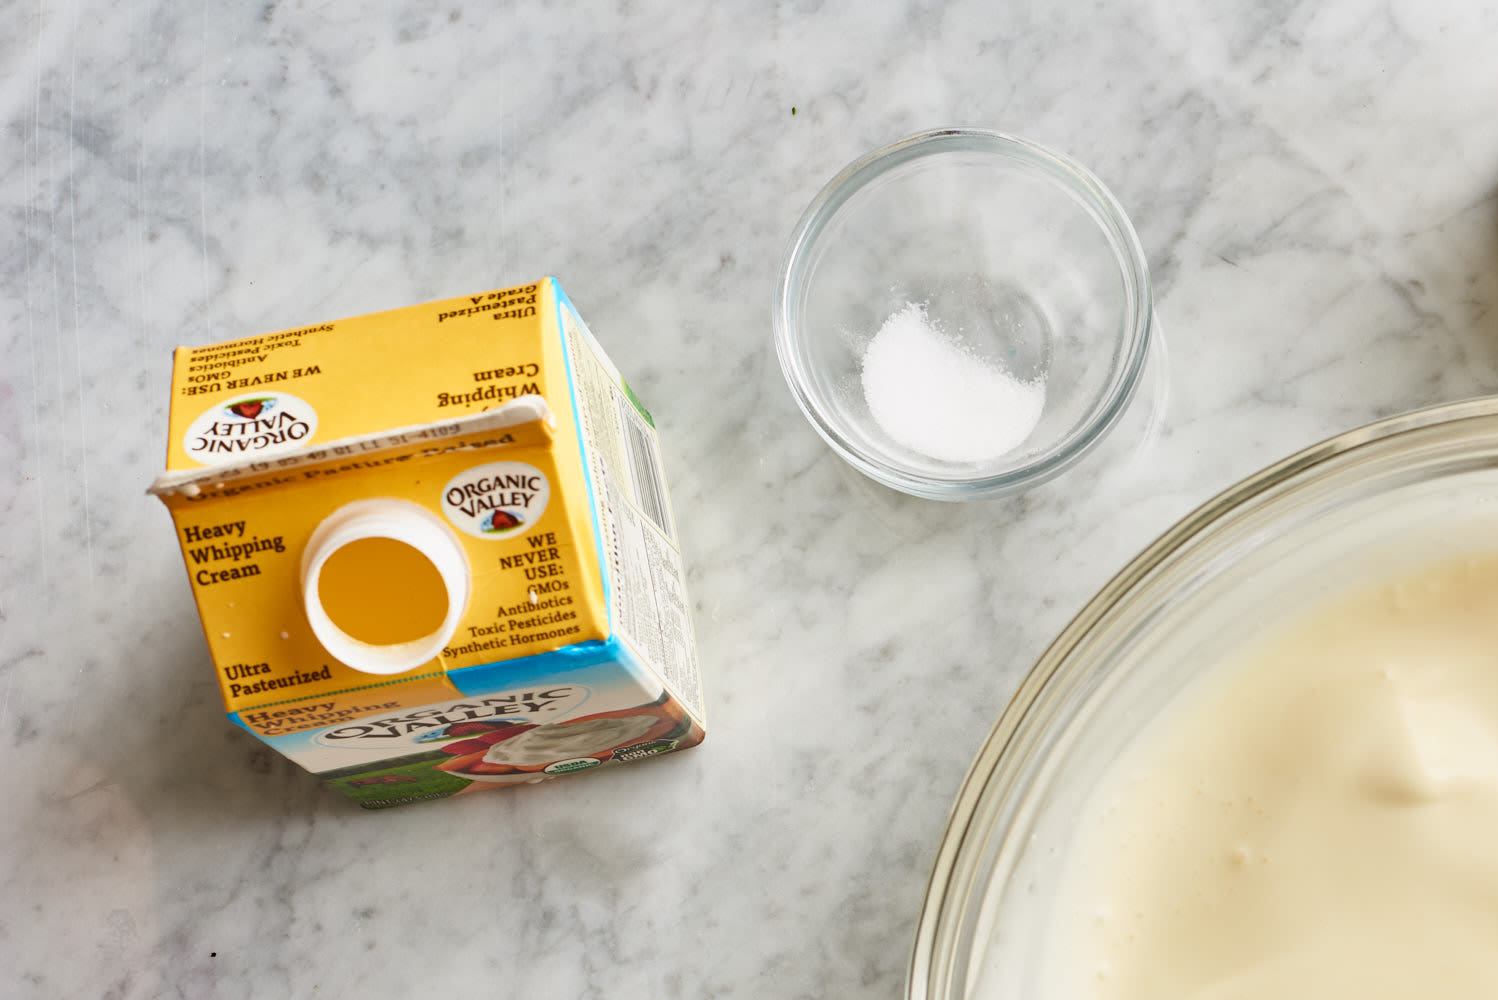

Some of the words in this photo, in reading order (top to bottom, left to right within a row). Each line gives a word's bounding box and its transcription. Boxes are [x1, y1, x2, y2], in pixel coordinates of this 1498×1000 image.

[487, 284, 537, 301] Grade
[438, 294, 537, 322] Pasteurized
[493, 306, 537, 321] Ultra
[270, 324, 335, 343] Synthetic
[190, 346, 260, 363] Pesticides
[191, 336, 264, 354] Hormones
[264, 339, 302, 351] Toxic
[189, 353, 268, 372] Antibiotics
[292, 365, 322, 378] WE
[473, 363, 540, 382] Cream
[187, 370, 232, 383] GMOs
[227, 371, 289, 390] NEVER
[181, 382, 222, 396] USE:
[437, 382, 541, 408] Whipping
[203, 411, 297, 437] VALLEY
[191, 420, 310, 453] ORGANIC
[186, 476, 297, 501] Organic
[303, 455, 413, 478] Pasture
[446, 474, 542, 507] ORGANIC
[459, 492, 536, 518] VALLEY
[183, 521, 246, 543] Heavy
[527, 532, 557, 548] WE
[189, 536, 286, 565] Whipping
[500, 548, 560, 570] NEVER
[196, 563, 262, 586] Cream
[524, 565, 564, 580] USE:
[527, 580, 570, 595] GMOs
[497, 595, 573, 618] Antibiotics
[468, 620, 506, 638] Toxic
[509, 610, 577, 630] Pesticides
[442, 634, 508, 658] Synthetic
[510, 624, 580, 646] Hormones
[224, 662, 271, 680] Ultra
[230, 665, 332, 698] Pasteurized
[246, 702, 336, 723] Heavy
[253, 701, 402, 729] Whipping
[325, 687, 573, 740] ORGANIC
[360, 700, 554, 739] VALLEY
[264, 716, 359, 736] Cream
